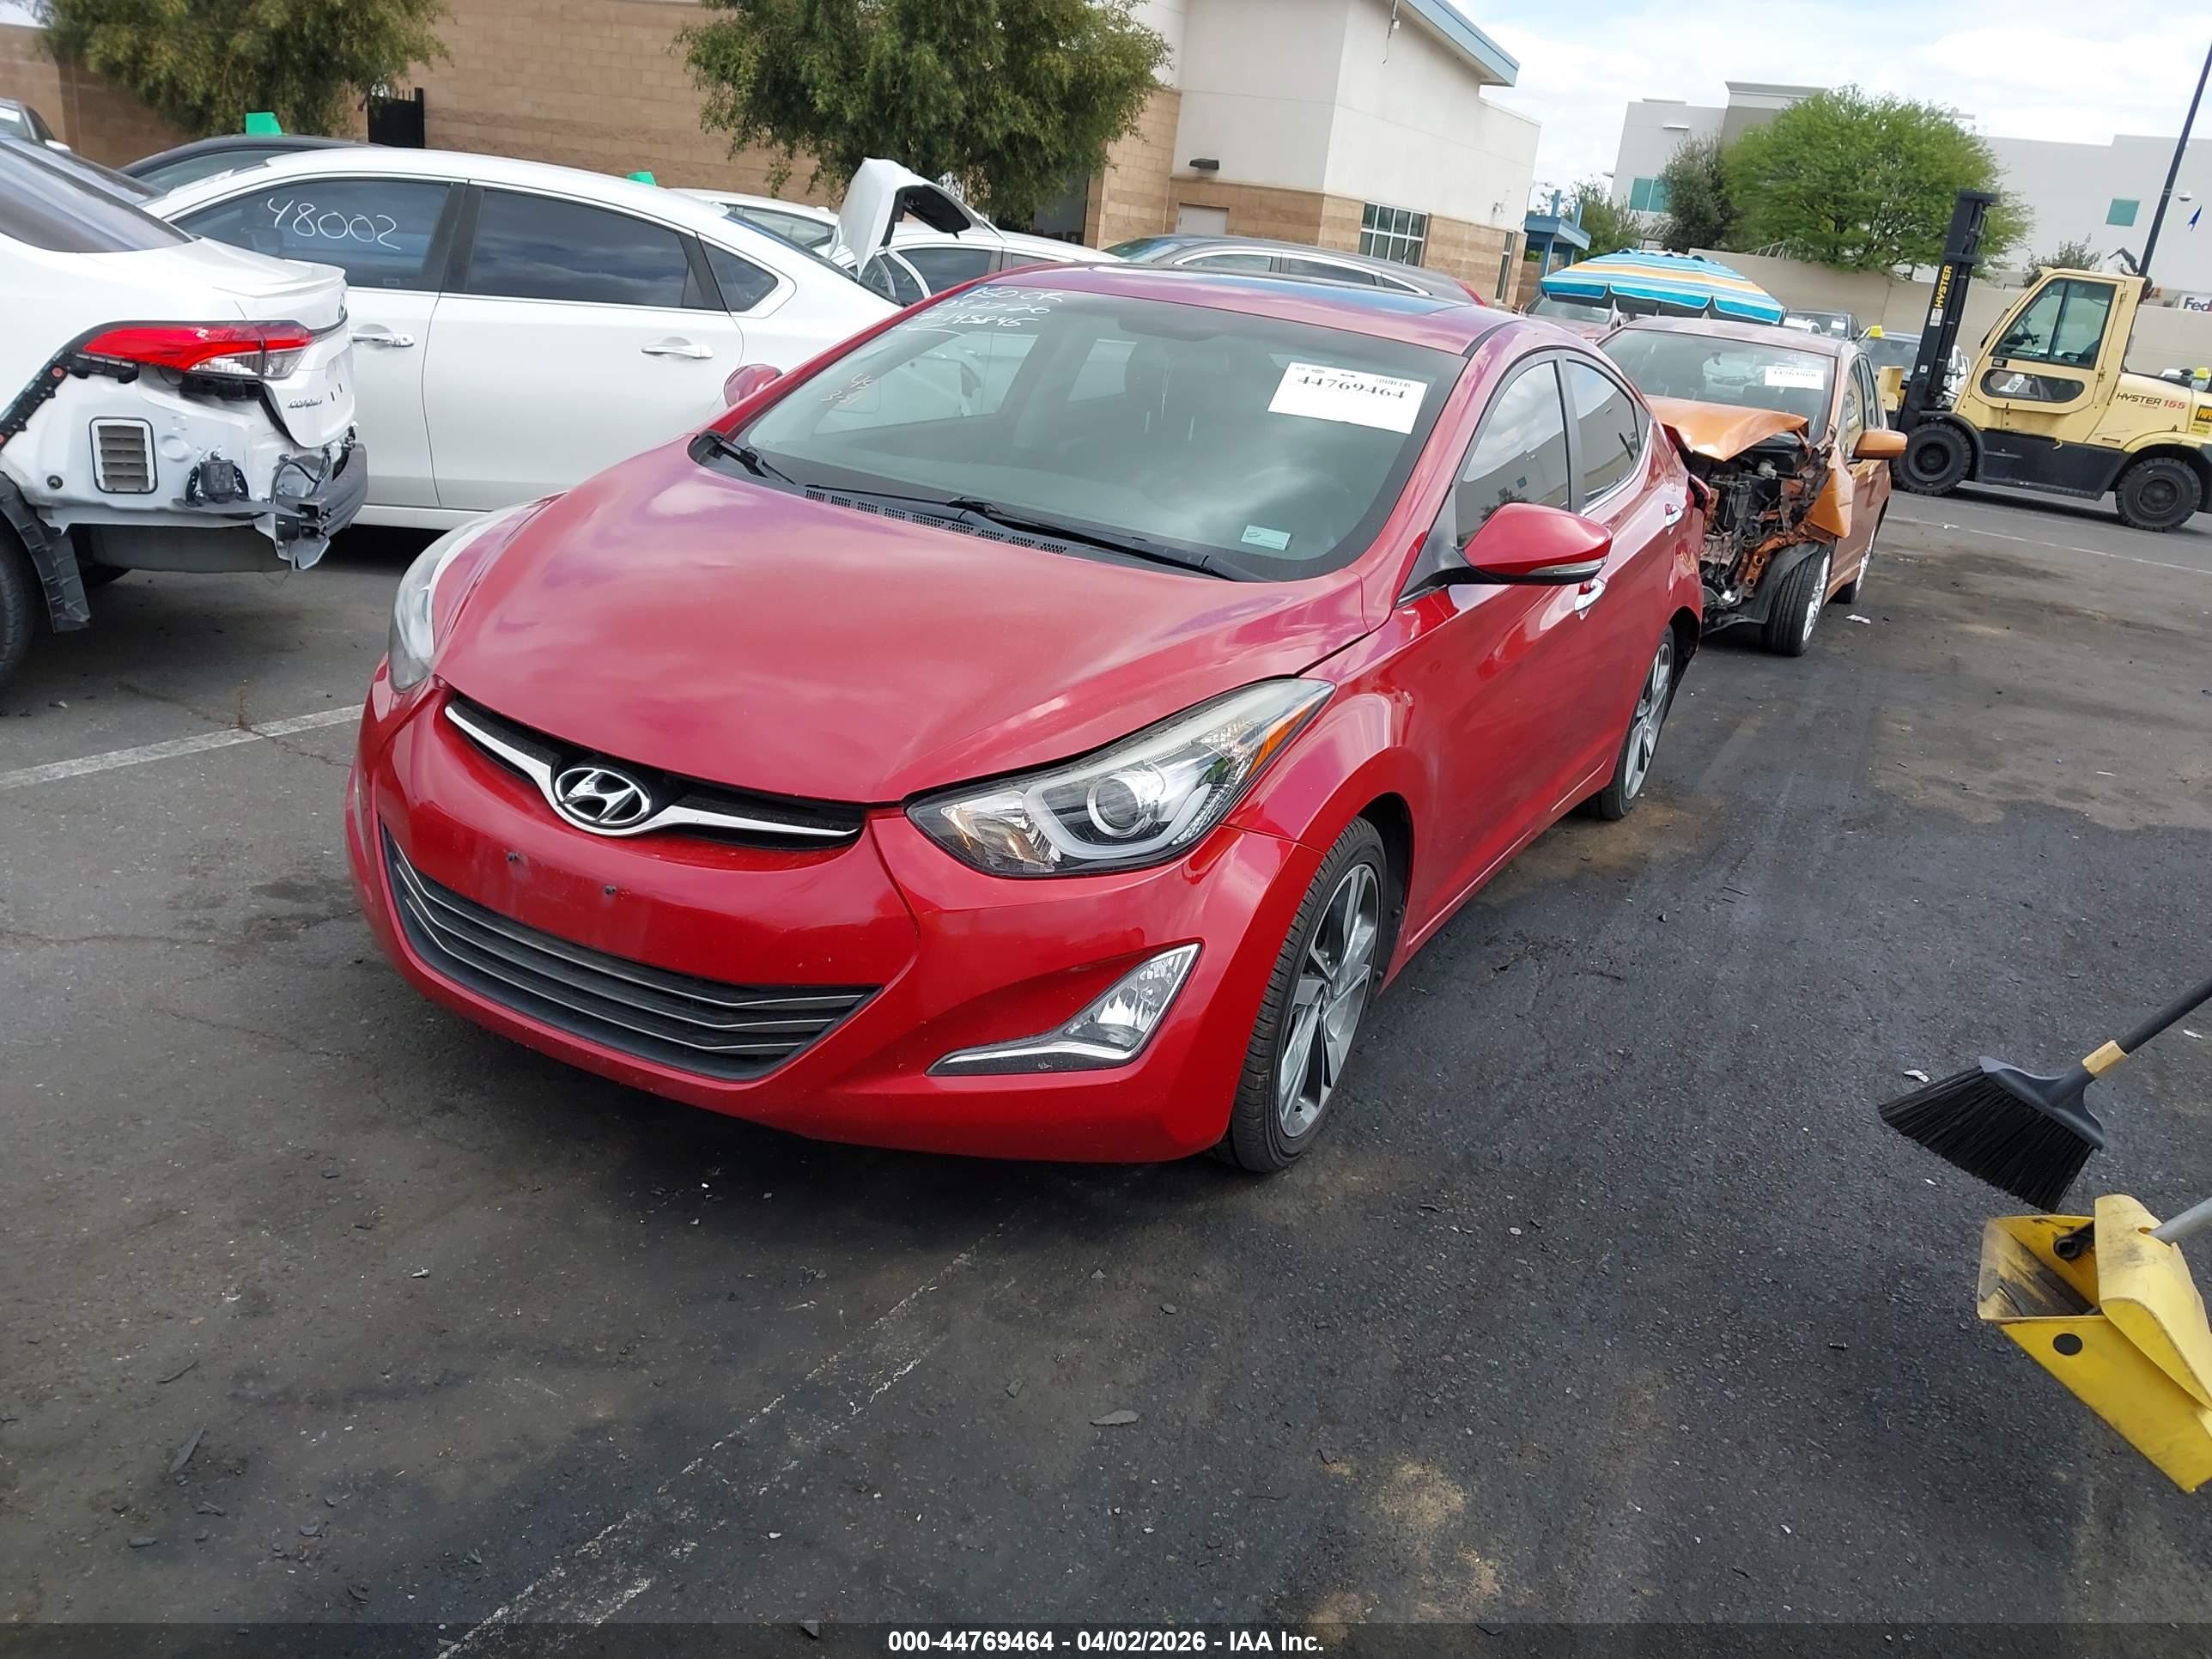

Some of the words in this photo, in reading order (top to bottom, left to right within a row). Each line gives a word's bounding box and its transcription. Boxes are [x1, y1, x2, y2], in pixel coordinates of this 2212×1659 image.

[267, 198, 401, 250] 48002
[1935, 264, 1953, 308] HYSTER
[1297, 376, 1405, 399] 44769464
[2116, 392, 2162, 406] HYSTER
